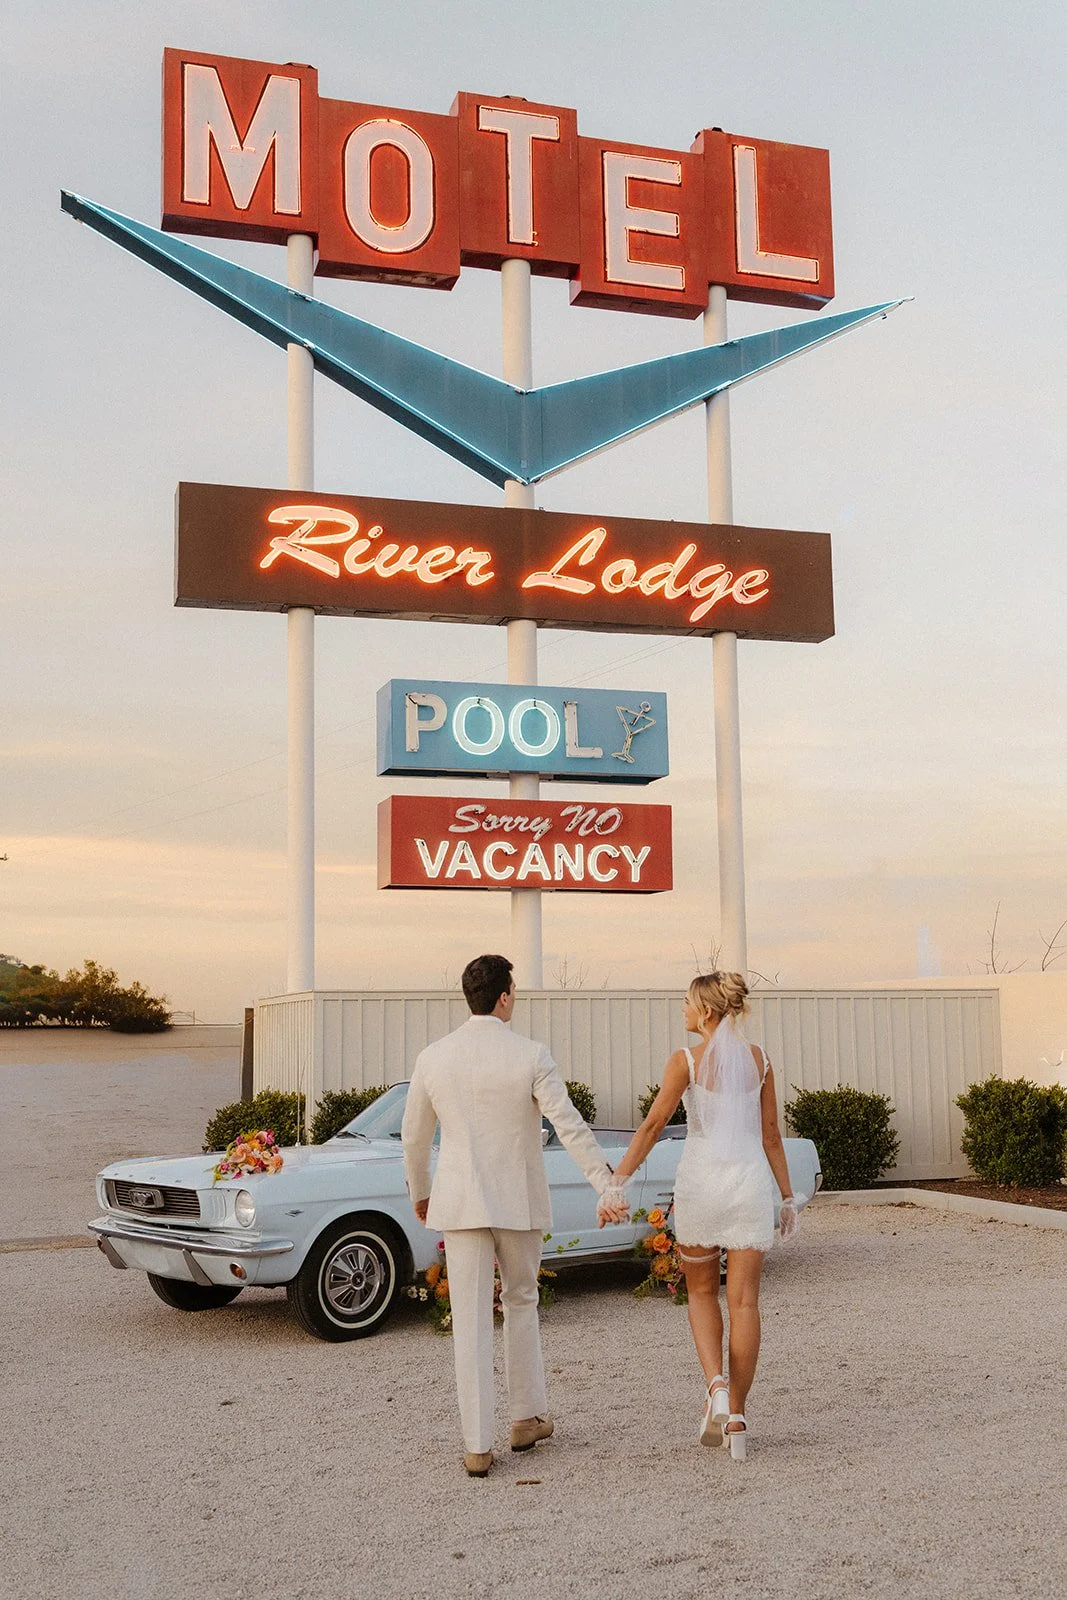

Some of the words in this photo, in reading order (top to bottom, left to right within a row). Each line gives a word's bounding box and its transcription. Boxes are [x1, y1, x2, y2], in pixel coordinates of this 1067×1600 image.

[182, 63, 819, 290] MOTEL
[260, 504, 495, 587] River
[522, 527, 769, 622] Lodge
[405, 692, 603, 758] POOL
[448, 804, 552, 842] Sorry
[560, 805, 623, 837] NO
[414, 838, 650, 883] VACANCY
